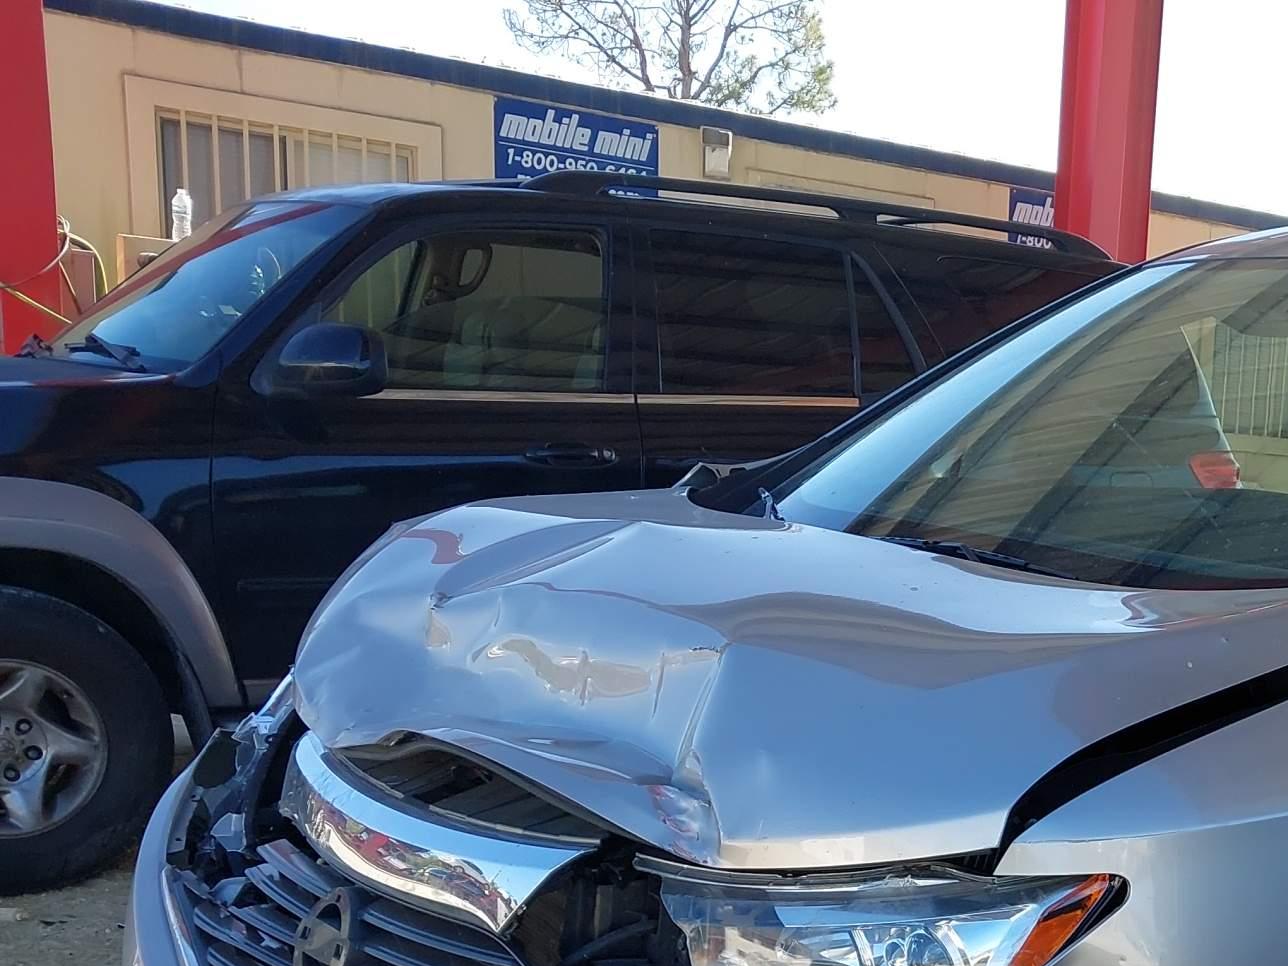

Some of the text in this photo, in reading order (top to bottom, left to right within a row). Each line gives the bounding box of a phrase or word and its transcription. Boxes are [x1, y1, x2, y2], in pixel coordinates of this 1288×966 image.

[499, 109, 654, 161] mobile mini
[1012, 197, 1055, 228] mob
